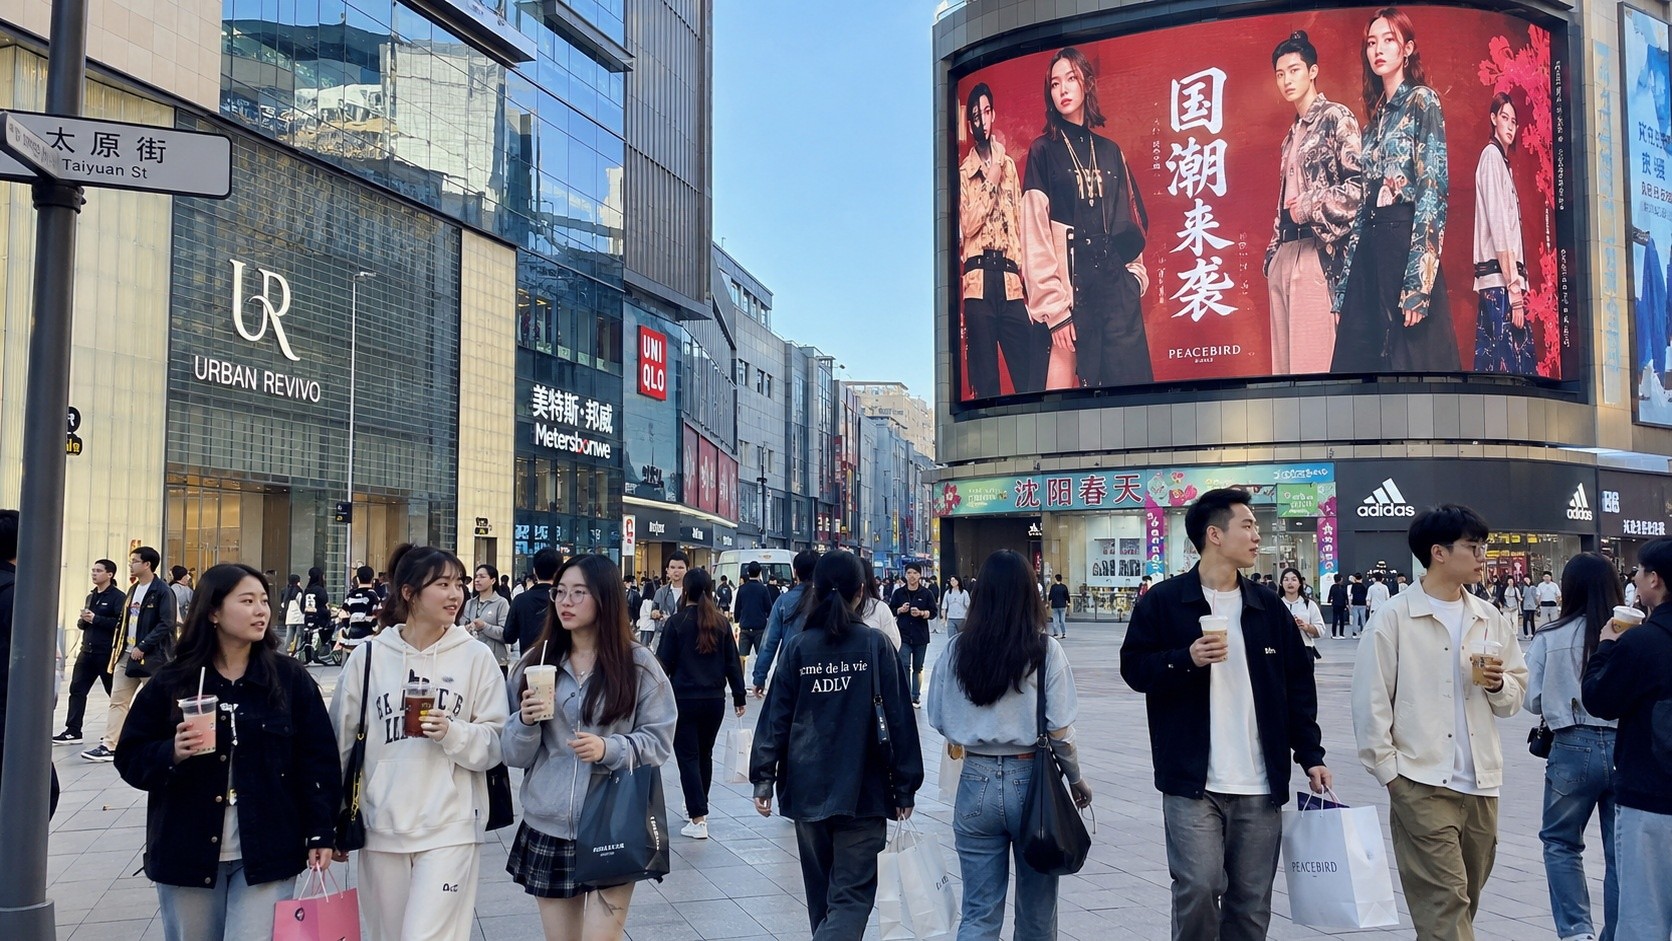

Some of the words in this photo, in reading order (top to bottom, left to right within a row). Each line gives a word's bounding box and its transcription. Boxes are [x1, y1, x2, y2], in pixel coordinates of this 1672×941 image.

[46, 126, 167, 164] 太原街
[62, 158, 124, 177] Taiyuan
[131, 165, 148, 179] St
[1165, 66, 1239, 322] 国潮来袭
[643, 334, 662, 364] UNI
[1168, 344, 1241, 359] PEACEBIRD
[194, 355, 257, 391] URBAN
[263, 370, 321, 403] REVIVO
[643, 363, 665, 392] QLO
[1014, 474, 1144, 507] 沈阳春天
[1356, 502, 1416, 517] adidas
[825, 662, 839, 674] de
[840, 661, 850, 672] la
[852, 660, 868, 672] vie
[811, 675, 852, 693] ADLV
[1291, 861, 1338, 873] PEACEBIRD
